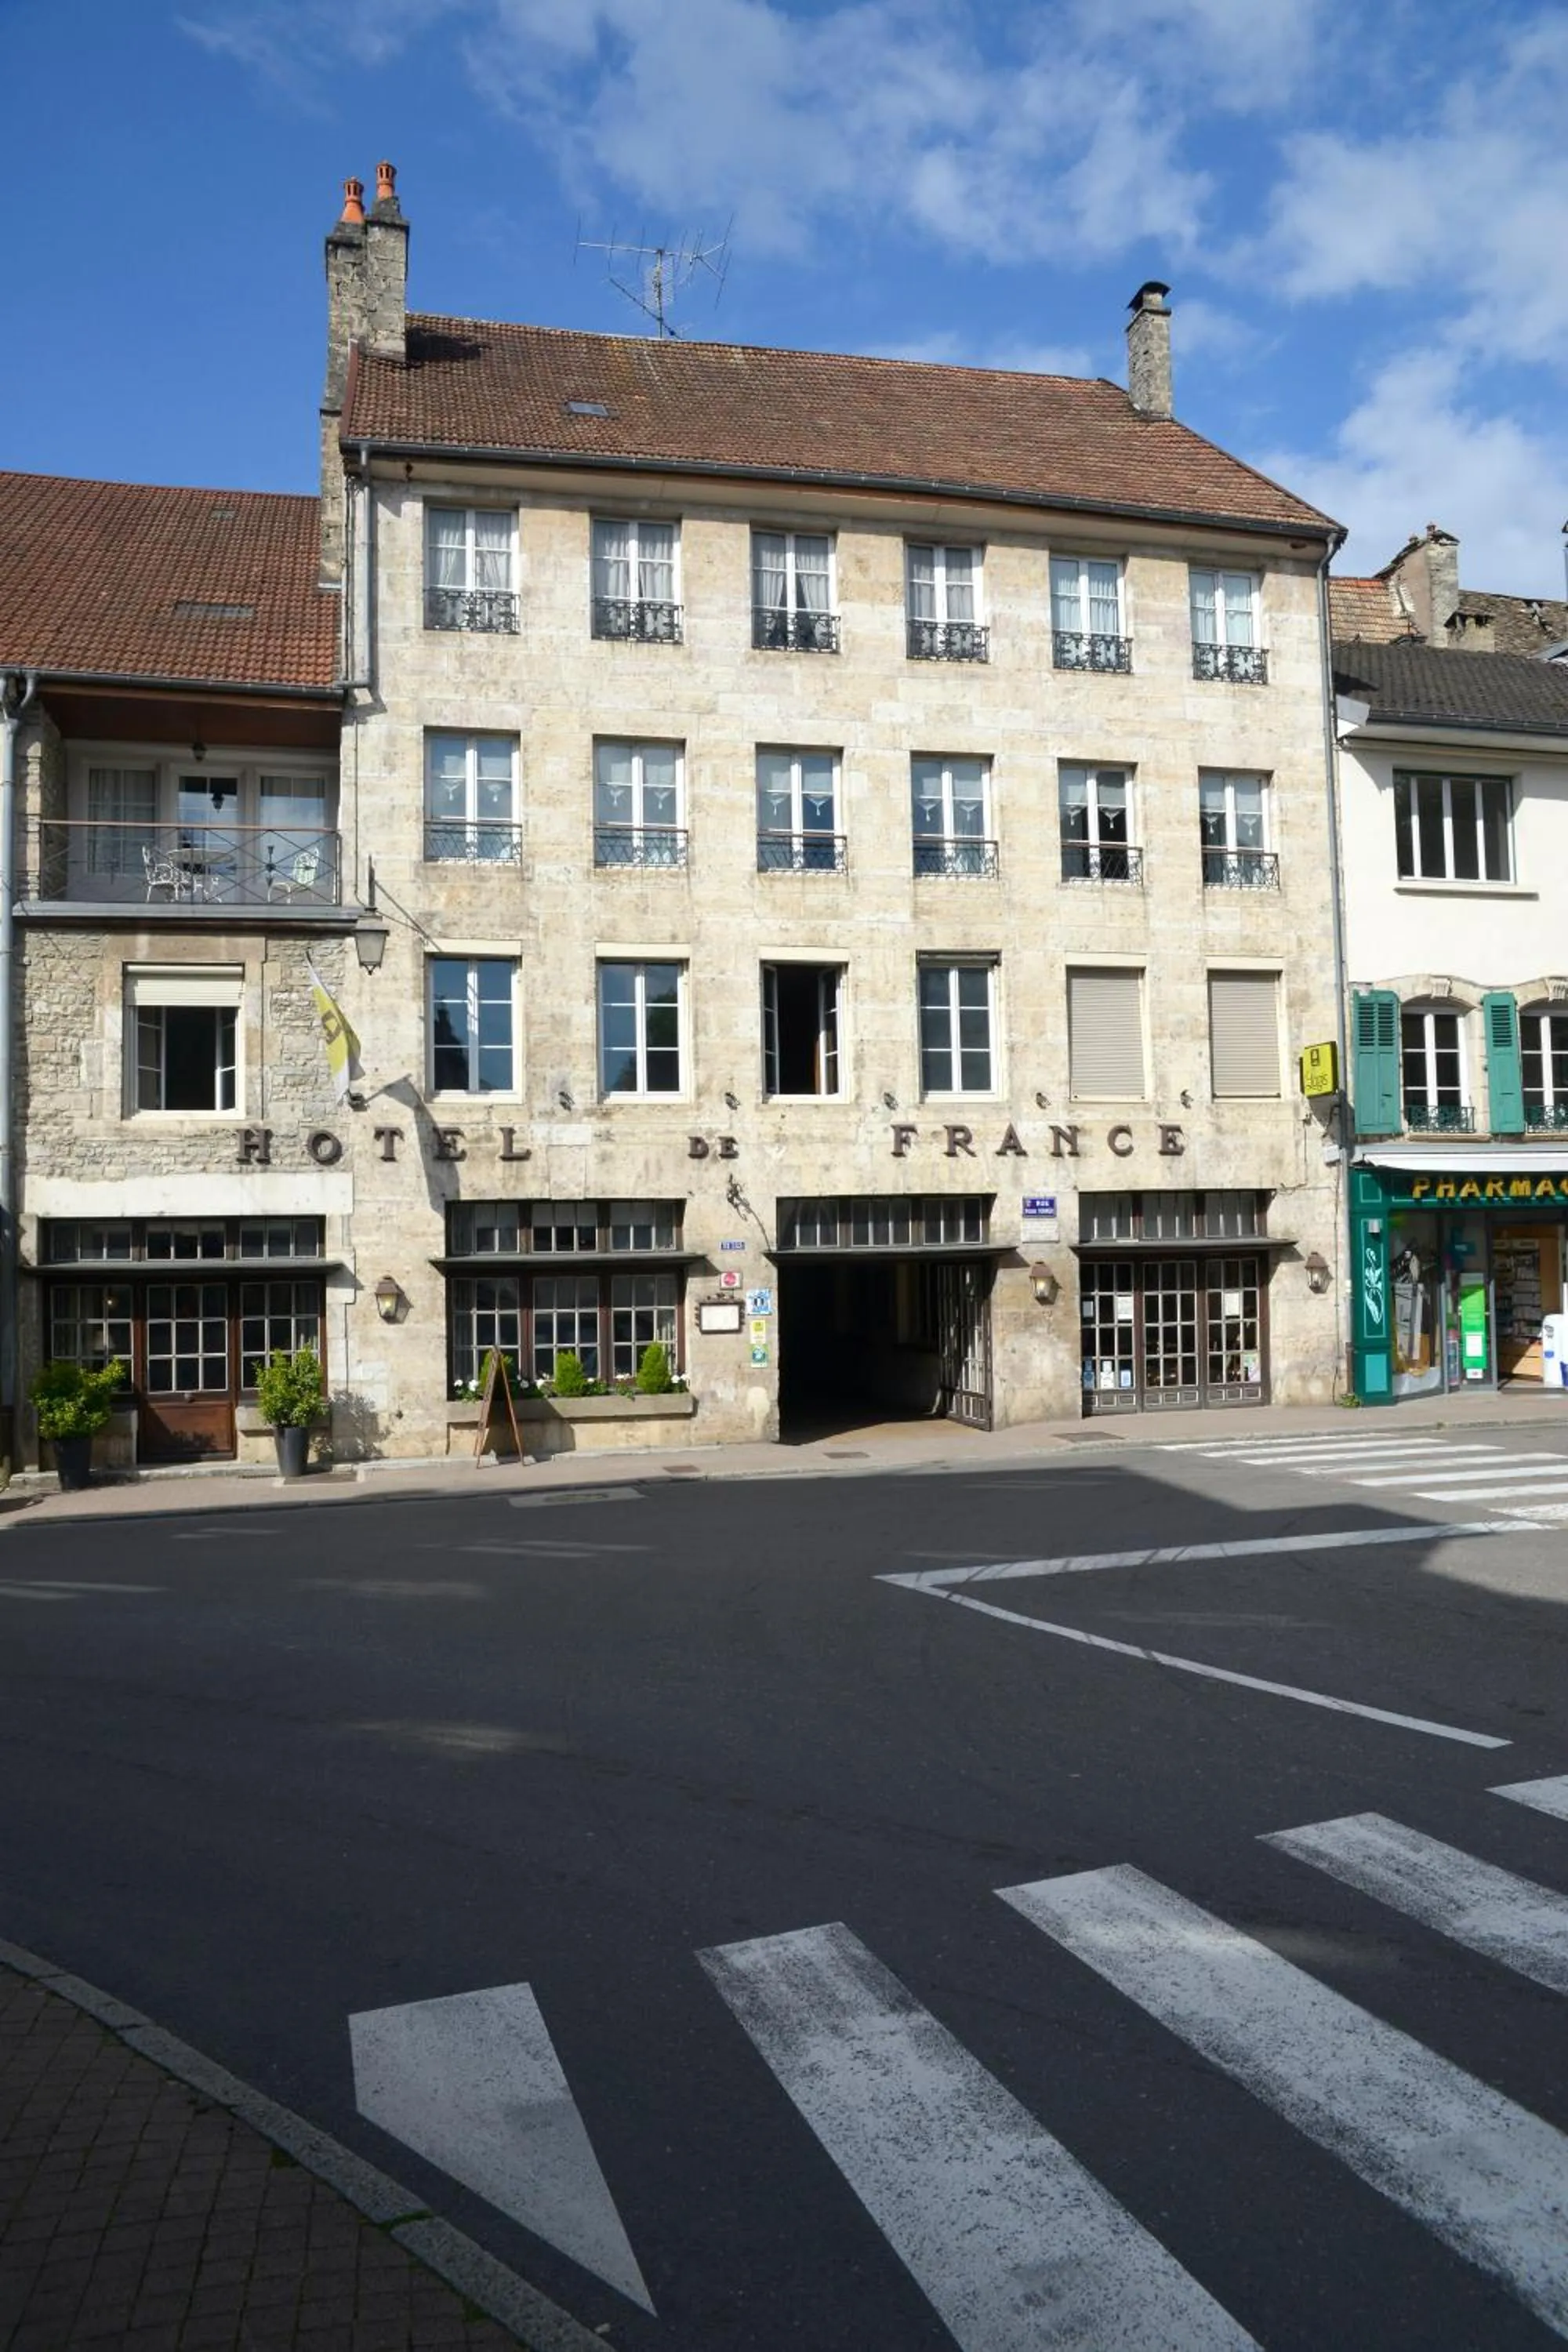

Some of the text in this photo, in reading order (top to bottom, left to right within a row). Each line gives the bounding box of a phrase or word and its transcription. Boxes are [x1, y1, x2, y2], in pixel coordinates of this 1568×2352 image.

[235, 1122, 1185, 1167] HOTEL DE FRANCE
